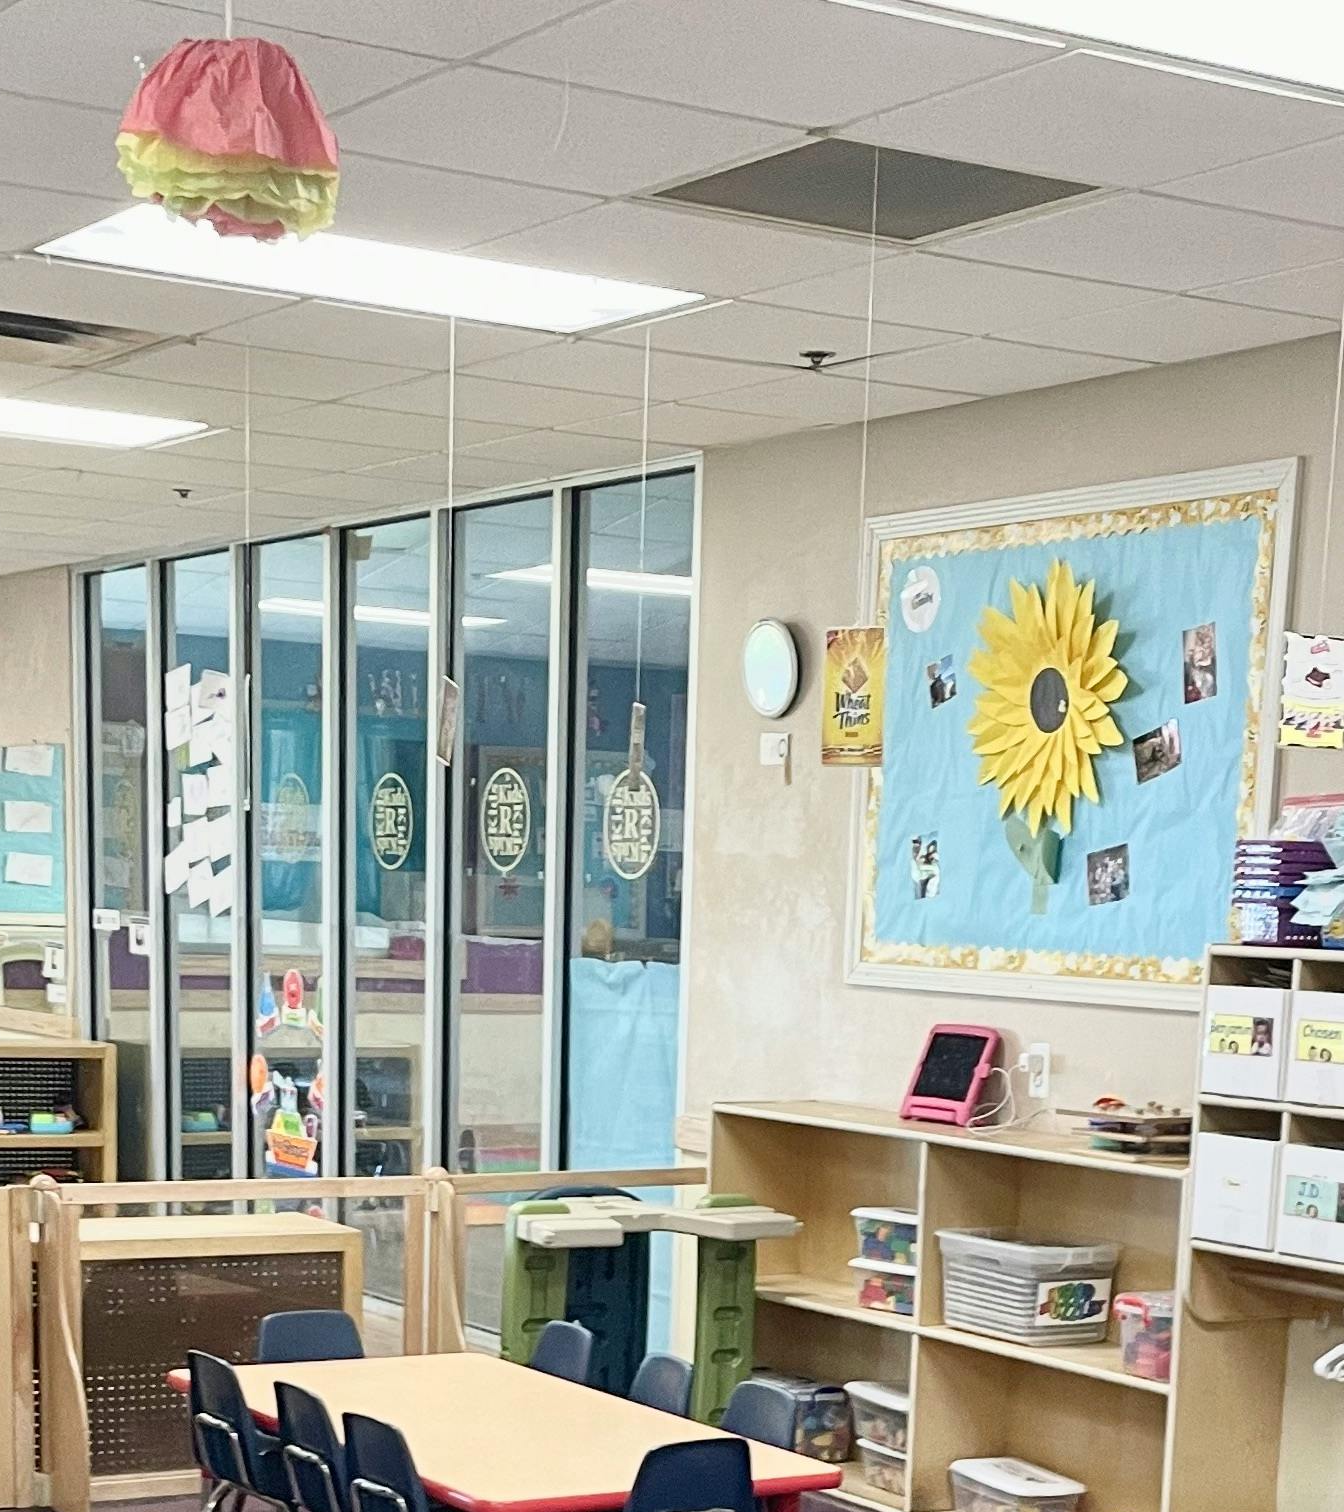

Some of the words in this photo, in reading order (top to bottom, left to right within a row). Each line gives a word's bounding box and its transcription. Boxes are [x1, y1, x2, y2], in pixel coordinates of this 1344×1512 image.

[834, 691, 871, 712] Wheat
[832, 711, 871, 730] Thins
[384, 807, 397, 834] R
[499, 805, 513, 834] R
[624, 808, 639, 839] R
